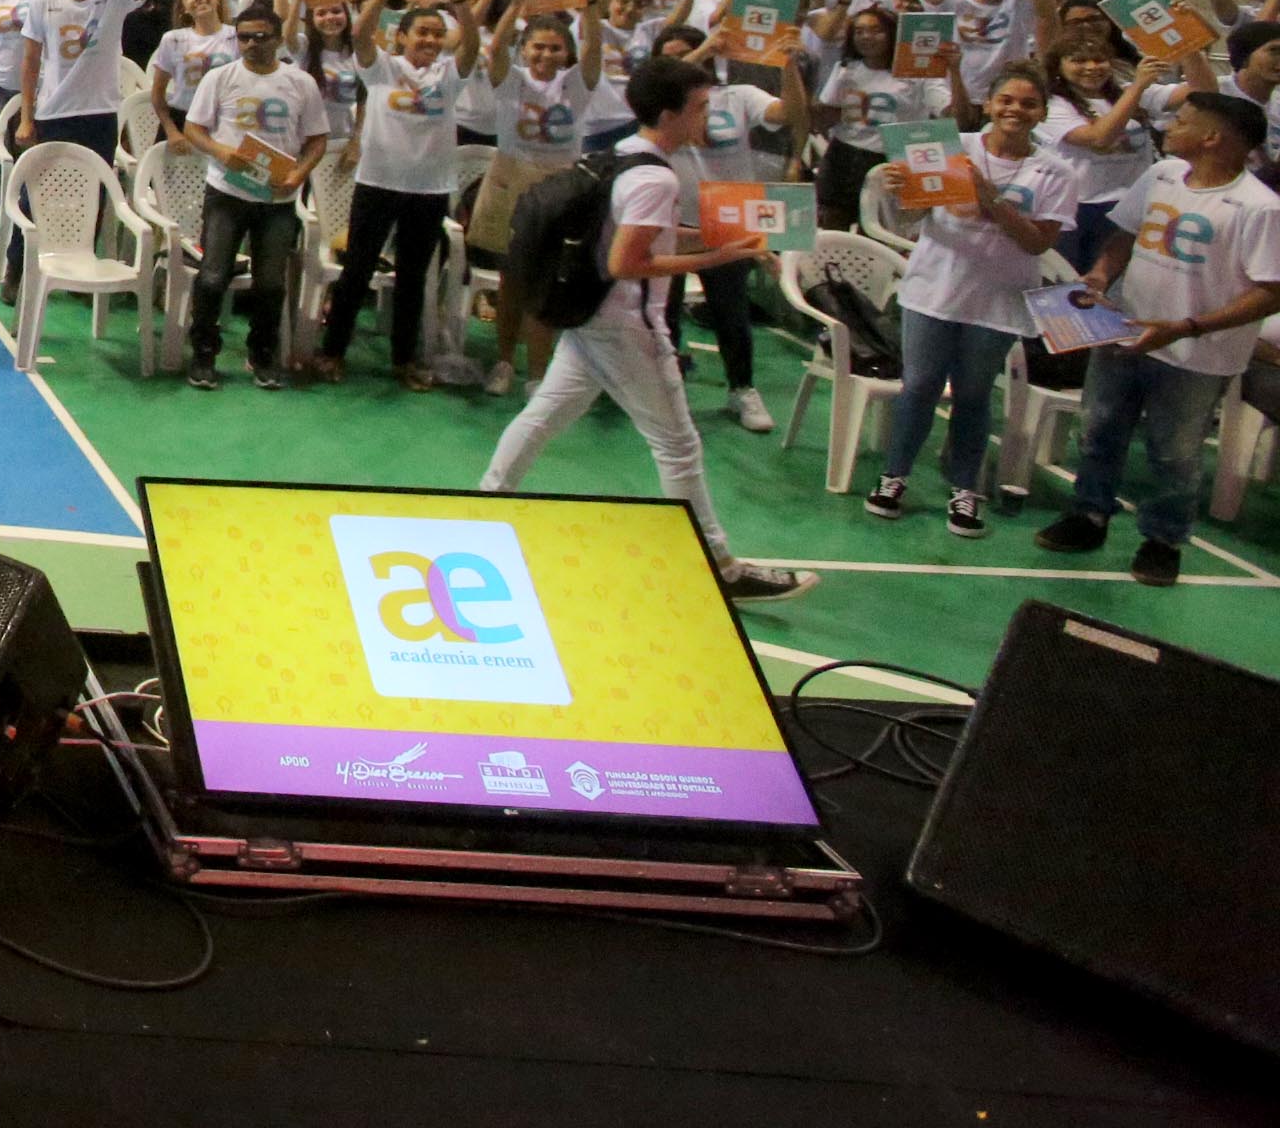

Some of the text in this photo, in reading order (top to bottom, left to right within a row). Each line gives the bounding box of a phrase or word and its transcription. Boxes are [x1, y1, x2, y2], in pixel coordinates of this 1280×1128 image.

[390, 648, 535, 668] academia enem
[279, 756, 310, 768] APOIO
[483, 766, 543, 778] SINDI
[605, 771, 715, 784] FUNDAÇÃO EDSON QUEIROZ
[607, 780, 665, 791] UNIVERSIDADE
[666, 783, 677, 791] DE
[678, 783, 723, 794] FORTALEZA
